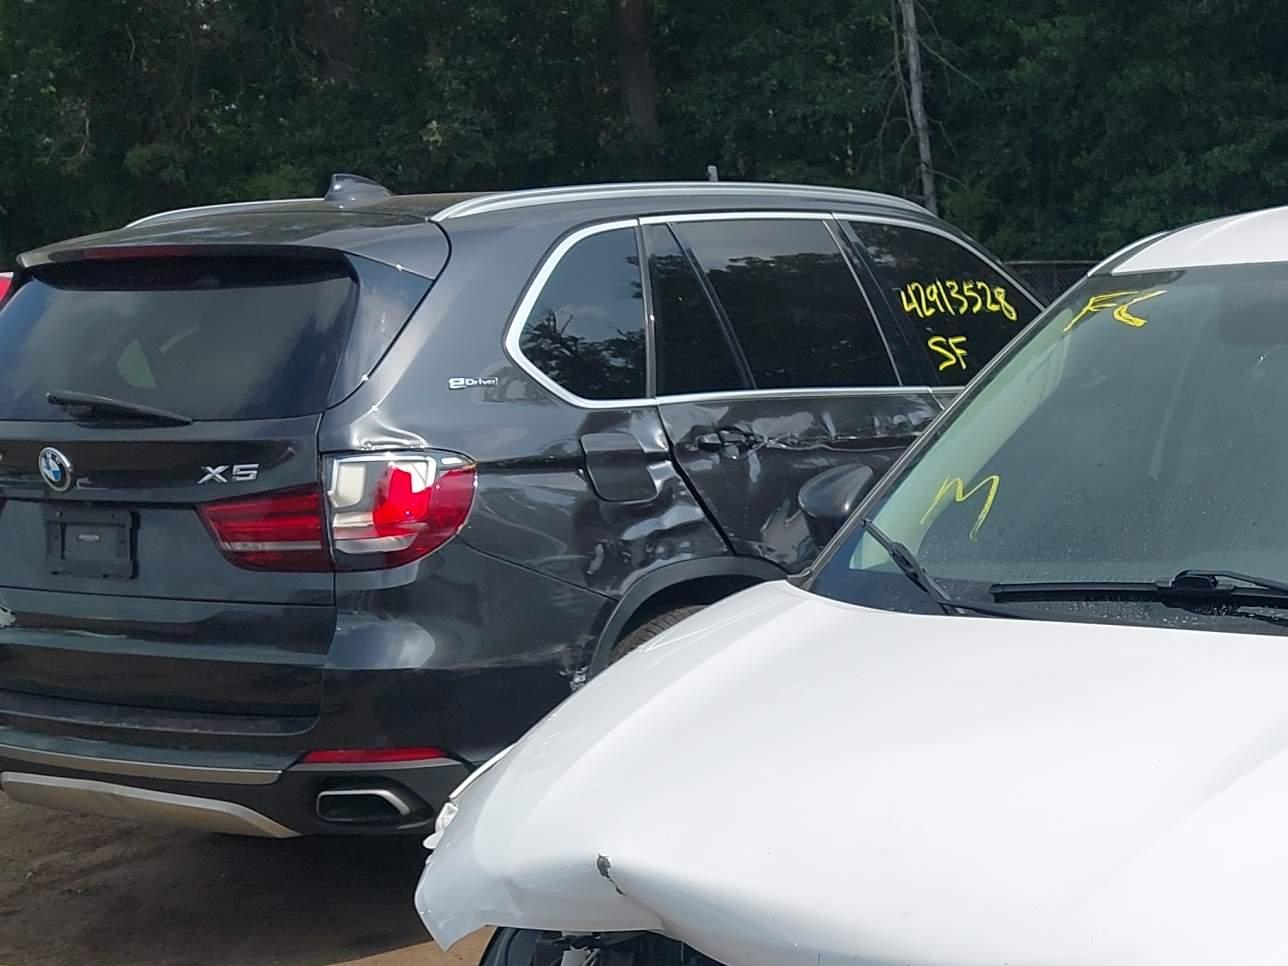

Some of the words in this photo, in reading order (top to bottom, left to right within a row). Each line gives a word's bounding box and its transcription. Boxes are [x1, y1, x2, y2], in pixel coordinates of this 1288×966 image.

[900, 279, 1018, 322] 42913528
[927, 335, 969, 371] SF
[198, 463, 260, 486] X5
[919, 474, 1001, 543] M
